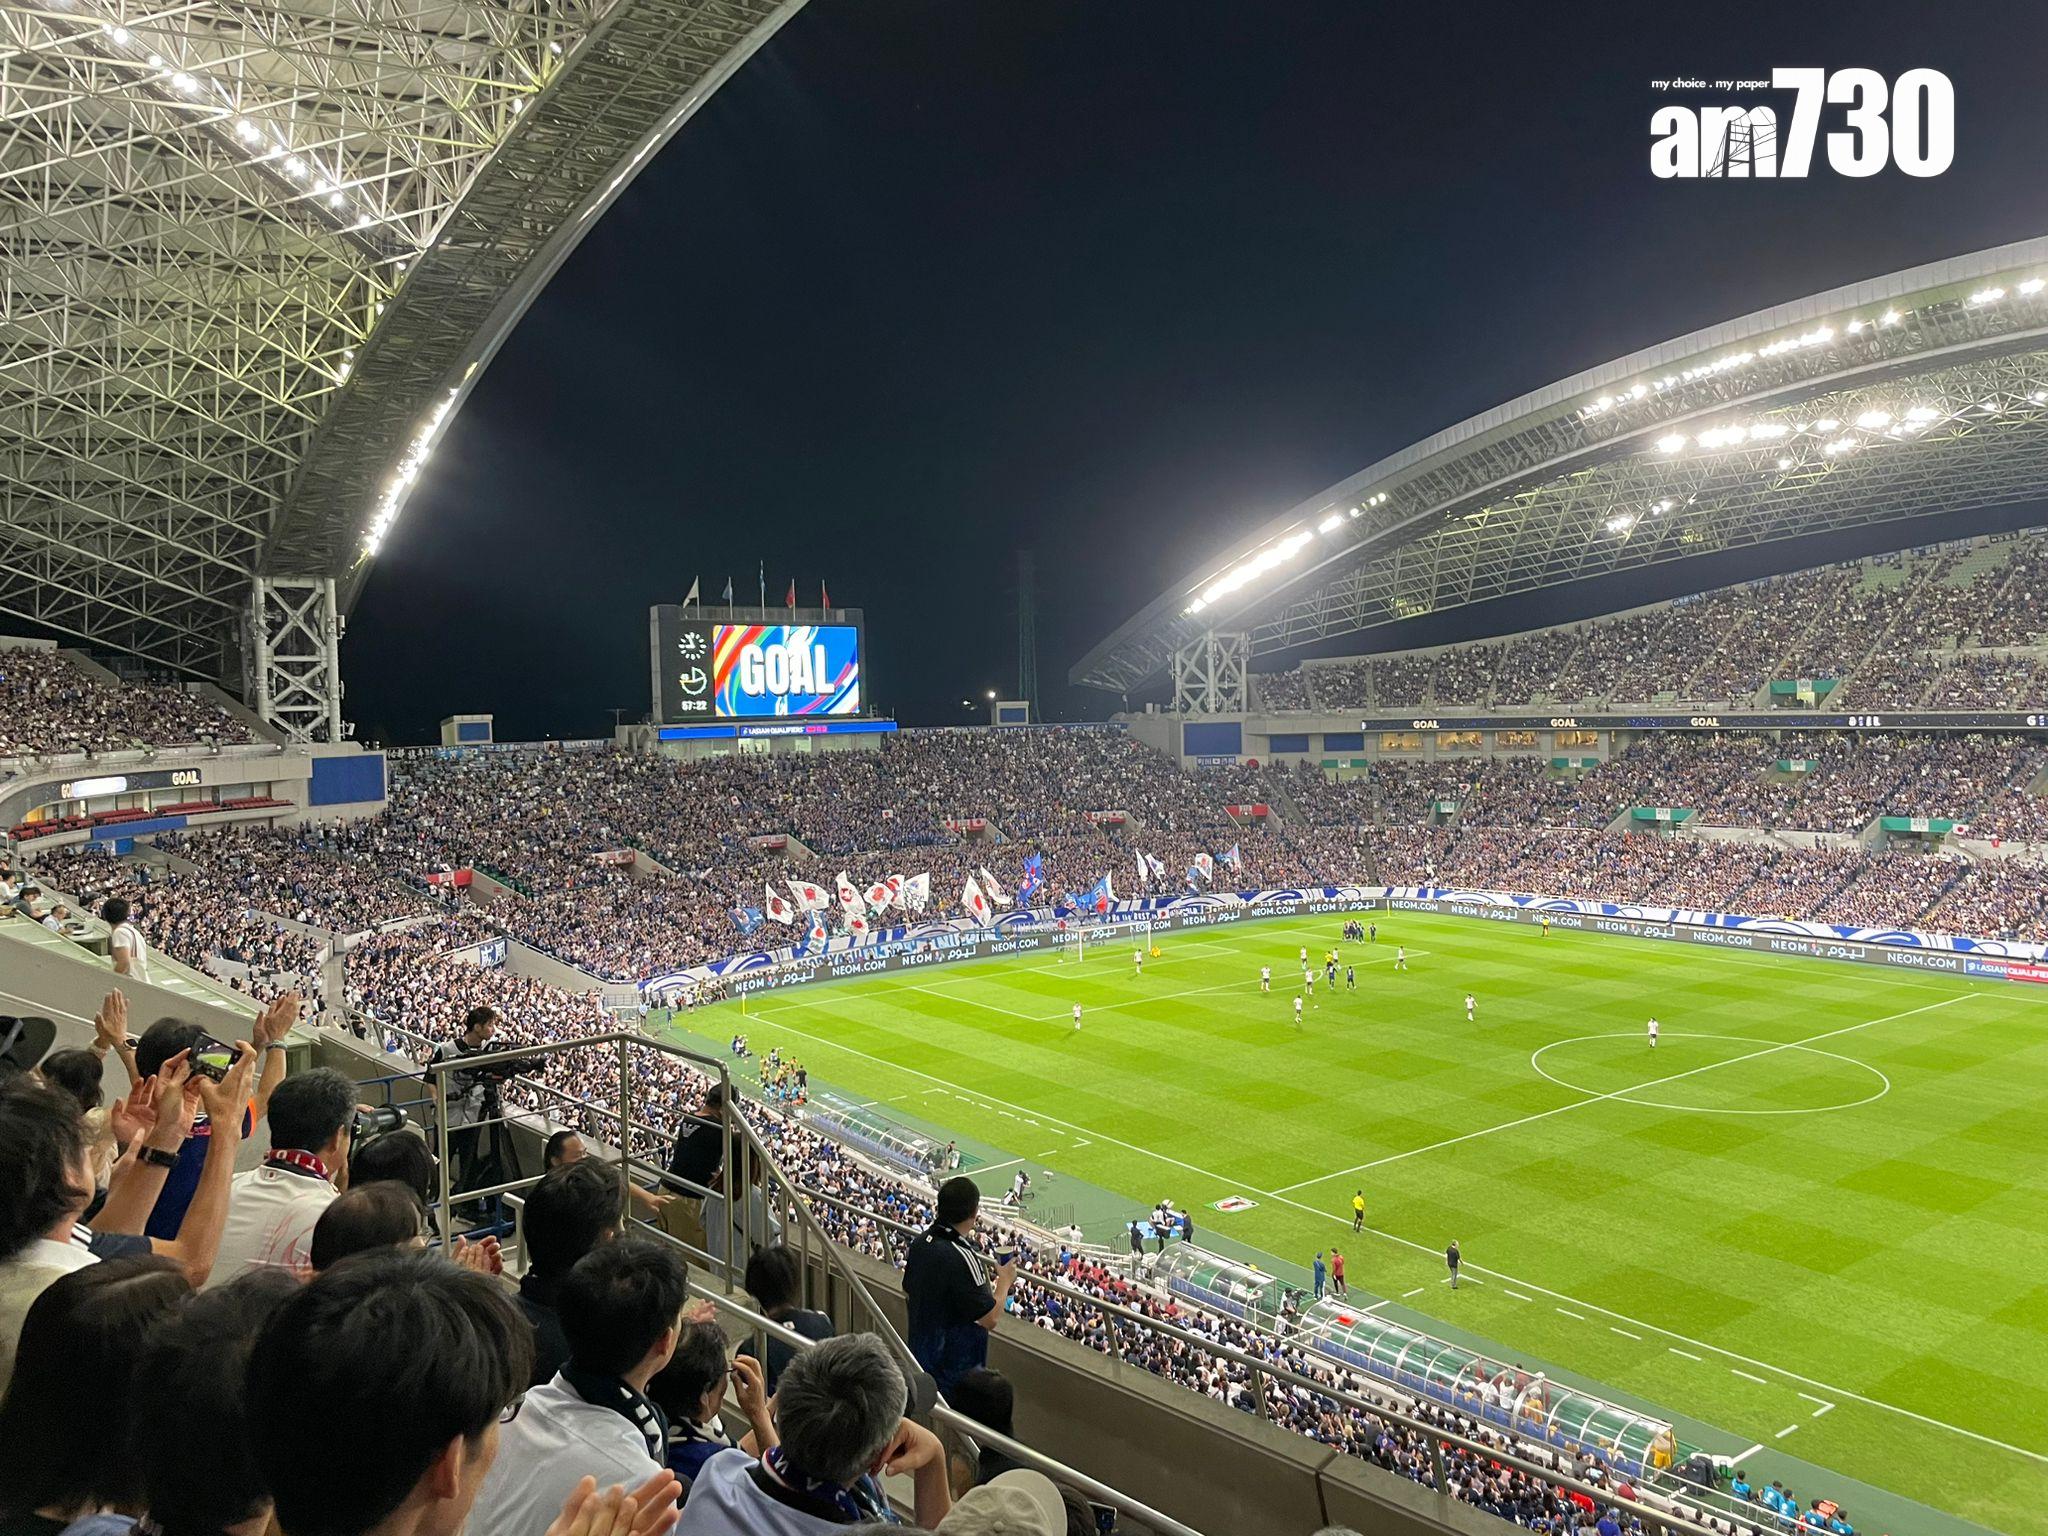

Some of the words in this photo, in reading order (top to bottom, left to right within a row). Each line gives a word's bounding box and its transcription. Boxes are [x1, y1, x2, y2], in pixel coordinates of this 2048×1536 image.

[739, 643, 835, 695] GOAL
[1412, 720, 1440, 729] GOAL
[1550, 718, 1577, 728] GOAL
[1690, 716, 1719, 727] GOAL
[172, 770, 200, 786] GOAL
[1251, 905, 1296, 917] NEOM.COM
[1309, 902, 1337, 912] NEOM
[1391, 900, 1438, 912] NEOM.COM
[1451, 905, 1478, 916] NEOM
[1182, 915, 1206, 926] NEOM
[1597, 920, 1627, 932] NEOM
[1052, 932, 1079, 944] NEOM
[1693, 931, 1752, 946] NEOM.COM
[991, 937, 1039, 953] NEOM.COM
[1771, 939, 1808, 954] NEOM
[902, 953, 933, 967] NEOM
[1887, 952, 1957, 969] NEOM.COM
[832, 960, 886, 977] NEOM.COM
[1980, 964, 2008, 974] ASIAN
[735, 976, 765, 994] NEOM
